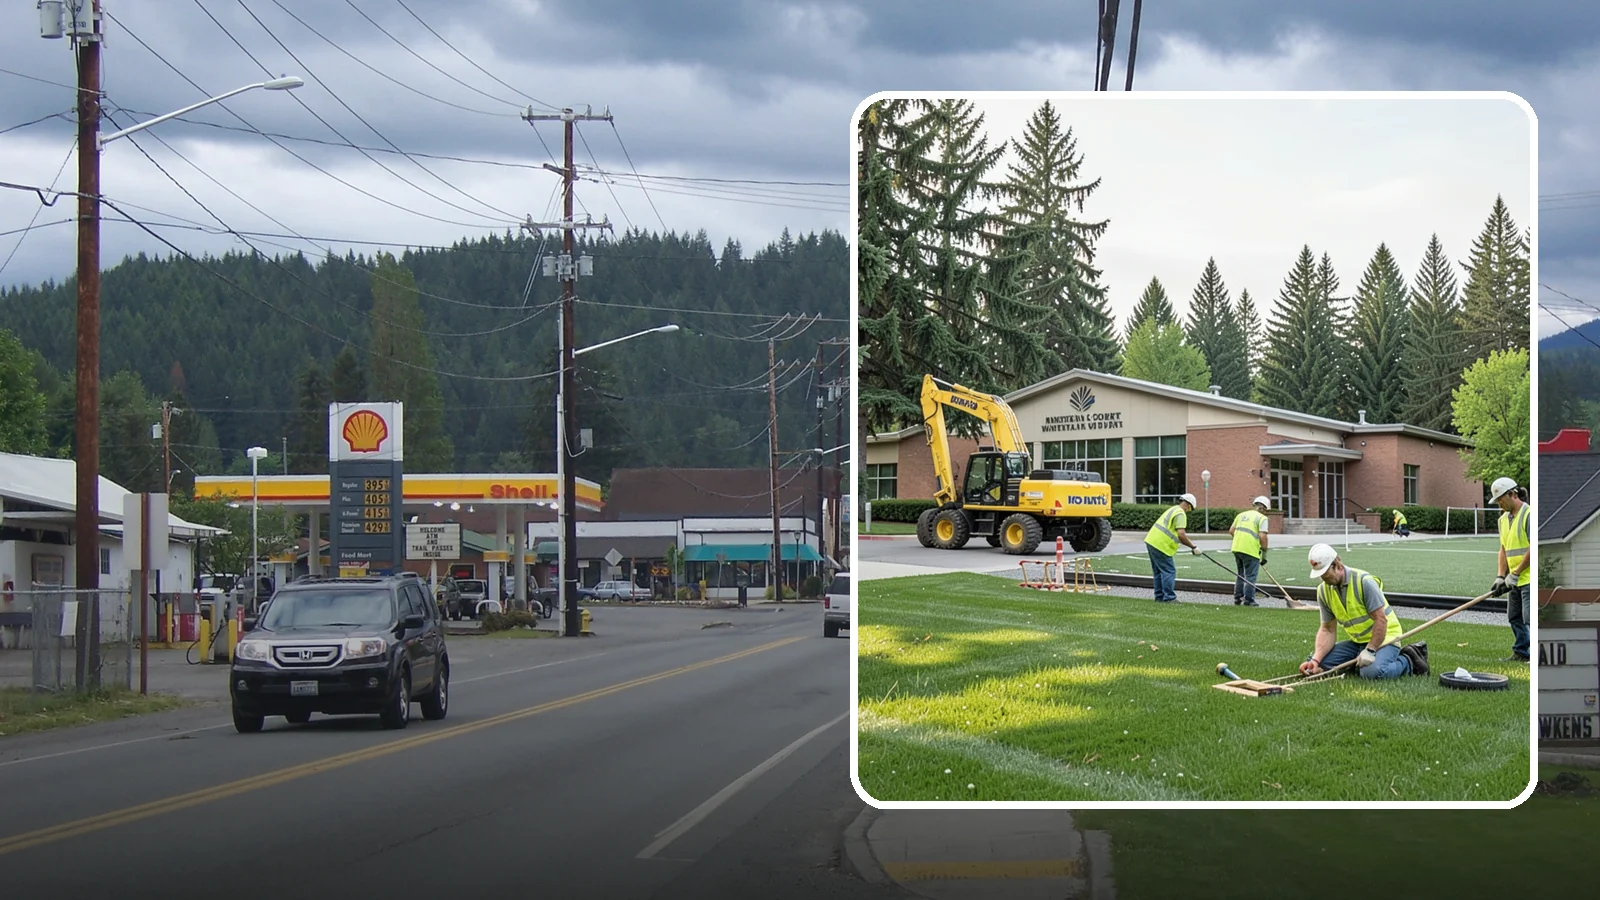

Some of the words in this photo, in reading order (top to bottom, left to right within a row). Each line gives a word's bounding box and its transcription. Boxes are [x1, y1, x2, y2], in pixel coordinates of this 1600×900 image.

[366, 480, 383, 490] 395
[489, 483, 547, 499] Shell
[365, 494, 383, 504] 405
[365, 508, 383, 518] 415
[366, 522, 383, 532] 429
